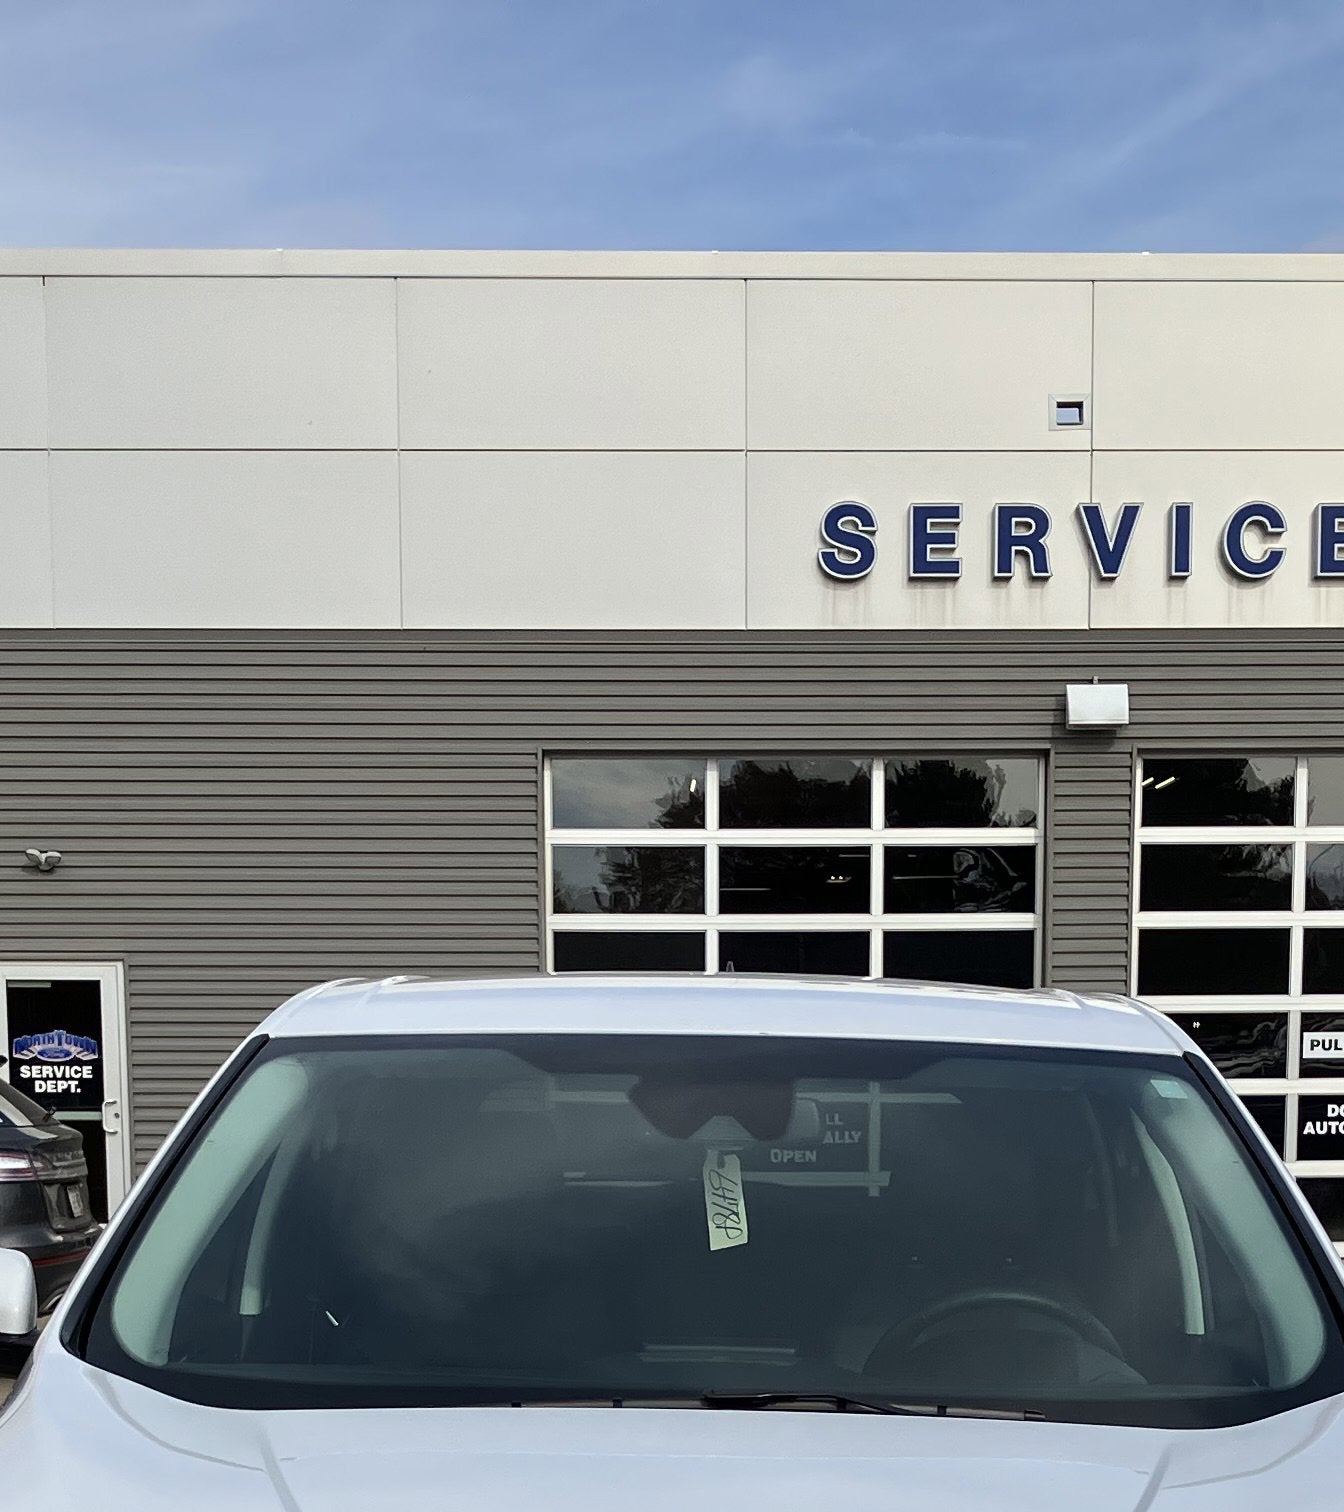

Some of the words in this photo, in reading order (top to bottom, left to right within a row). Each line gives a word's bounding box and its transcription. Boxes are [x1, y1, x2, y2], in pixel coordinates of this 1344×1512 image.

[19, 1065, 93, 1079] SERVICE
[34, 1080, 82, 1093] DEPT.
[769, 1148, 817, 1164] OPEN
